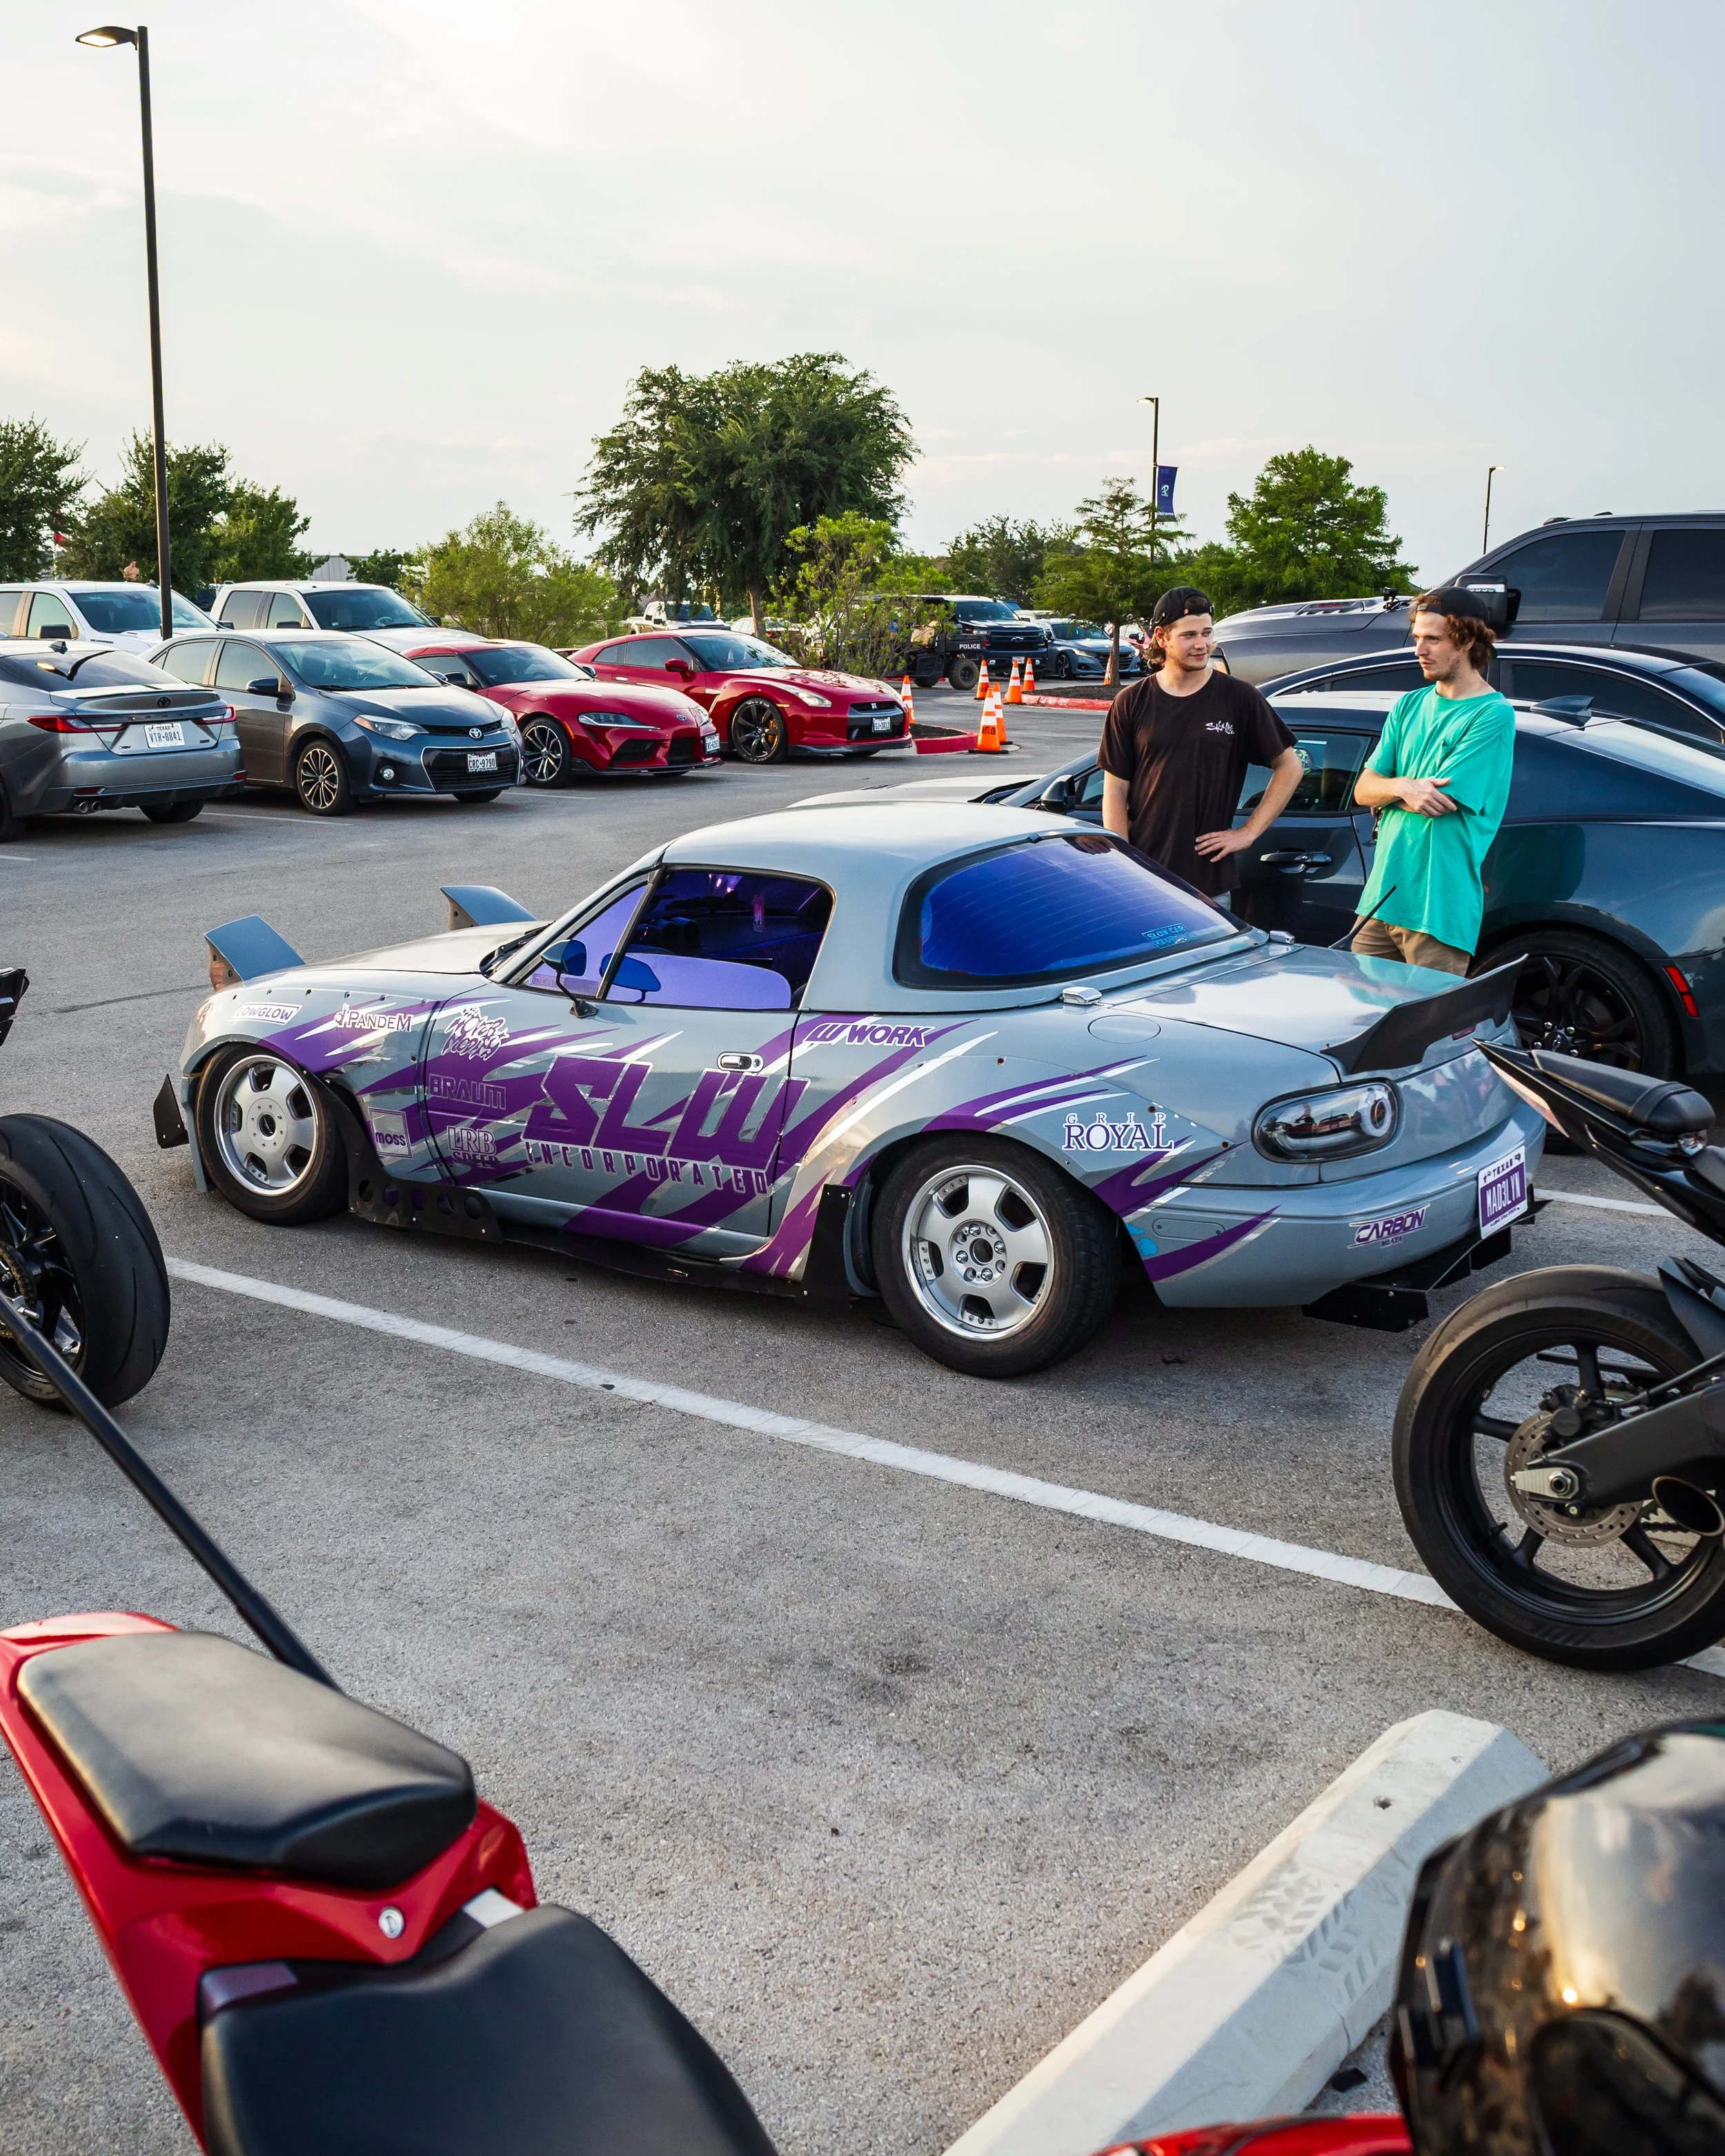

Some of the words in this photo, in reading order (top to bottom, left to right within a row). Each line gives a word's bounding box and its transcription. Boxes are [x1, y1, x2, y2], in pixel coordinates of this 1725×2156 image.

[1147, 929, 1169, 940] SLOW
[1169, 925, 1185, 934] CAR
[237, 1007, 293, 1020] LOWGLOW
[847, 1025, 933, 1045] WORK
[429, 1074, 506, 1109] BRAUM
[520, 1055, 811, 1171] SLW
[1067, 1114, 1164, 1124] GRIP
[375, 1132, 406, 1146] moss
[448, 1126, 496, 1155] LRB
[1064, 1124, 1172, 1149] ROYAL
[524, 1140, 769, 1196] INCORPORATED
[1493, 1158, 1513, 1177] TEXAS
[1486, 1171, 1521, 1217] MAD3LYN
[1356, 1209, 1425, 1243] CARBON
[1381, 1236, 1402, 1247] MIATA
